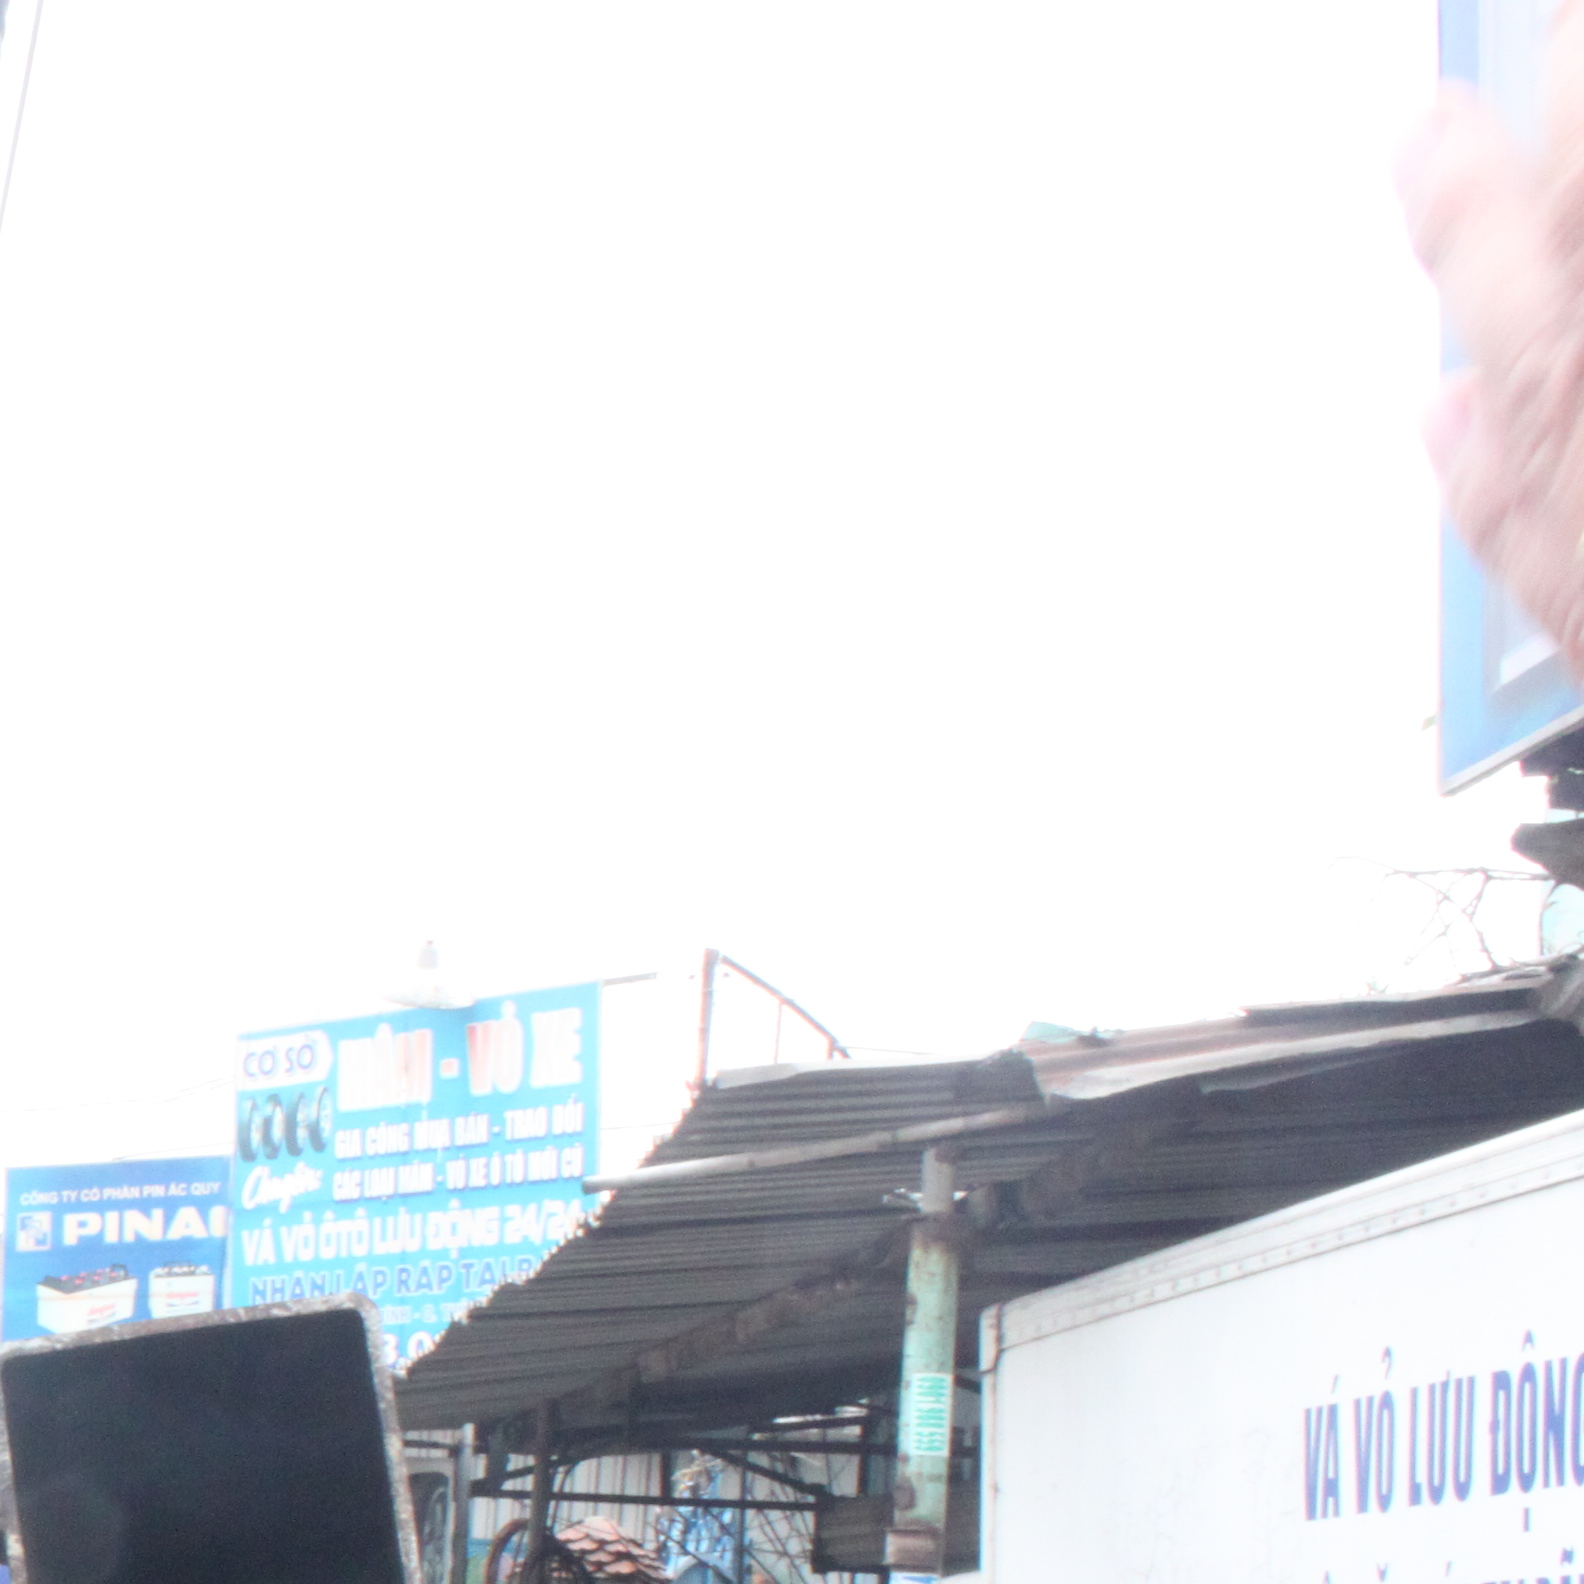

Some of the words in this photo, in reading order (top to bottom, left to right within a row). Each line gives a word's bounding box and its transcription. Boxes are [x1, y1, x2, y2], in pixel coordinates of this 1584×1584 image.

[529, 1007, 584, 1088] XE
[61, 1189, 80, 1204] TY
[142, 1183, 166, 1199] PIN
[242, 1217, 277, 1266] VÁ
[1304, 1373, 1342, 1522] VÁ
[1353, 1345, 1396, 1516] VỎ
[1407, 1368, 1477, 1508] LƯU
